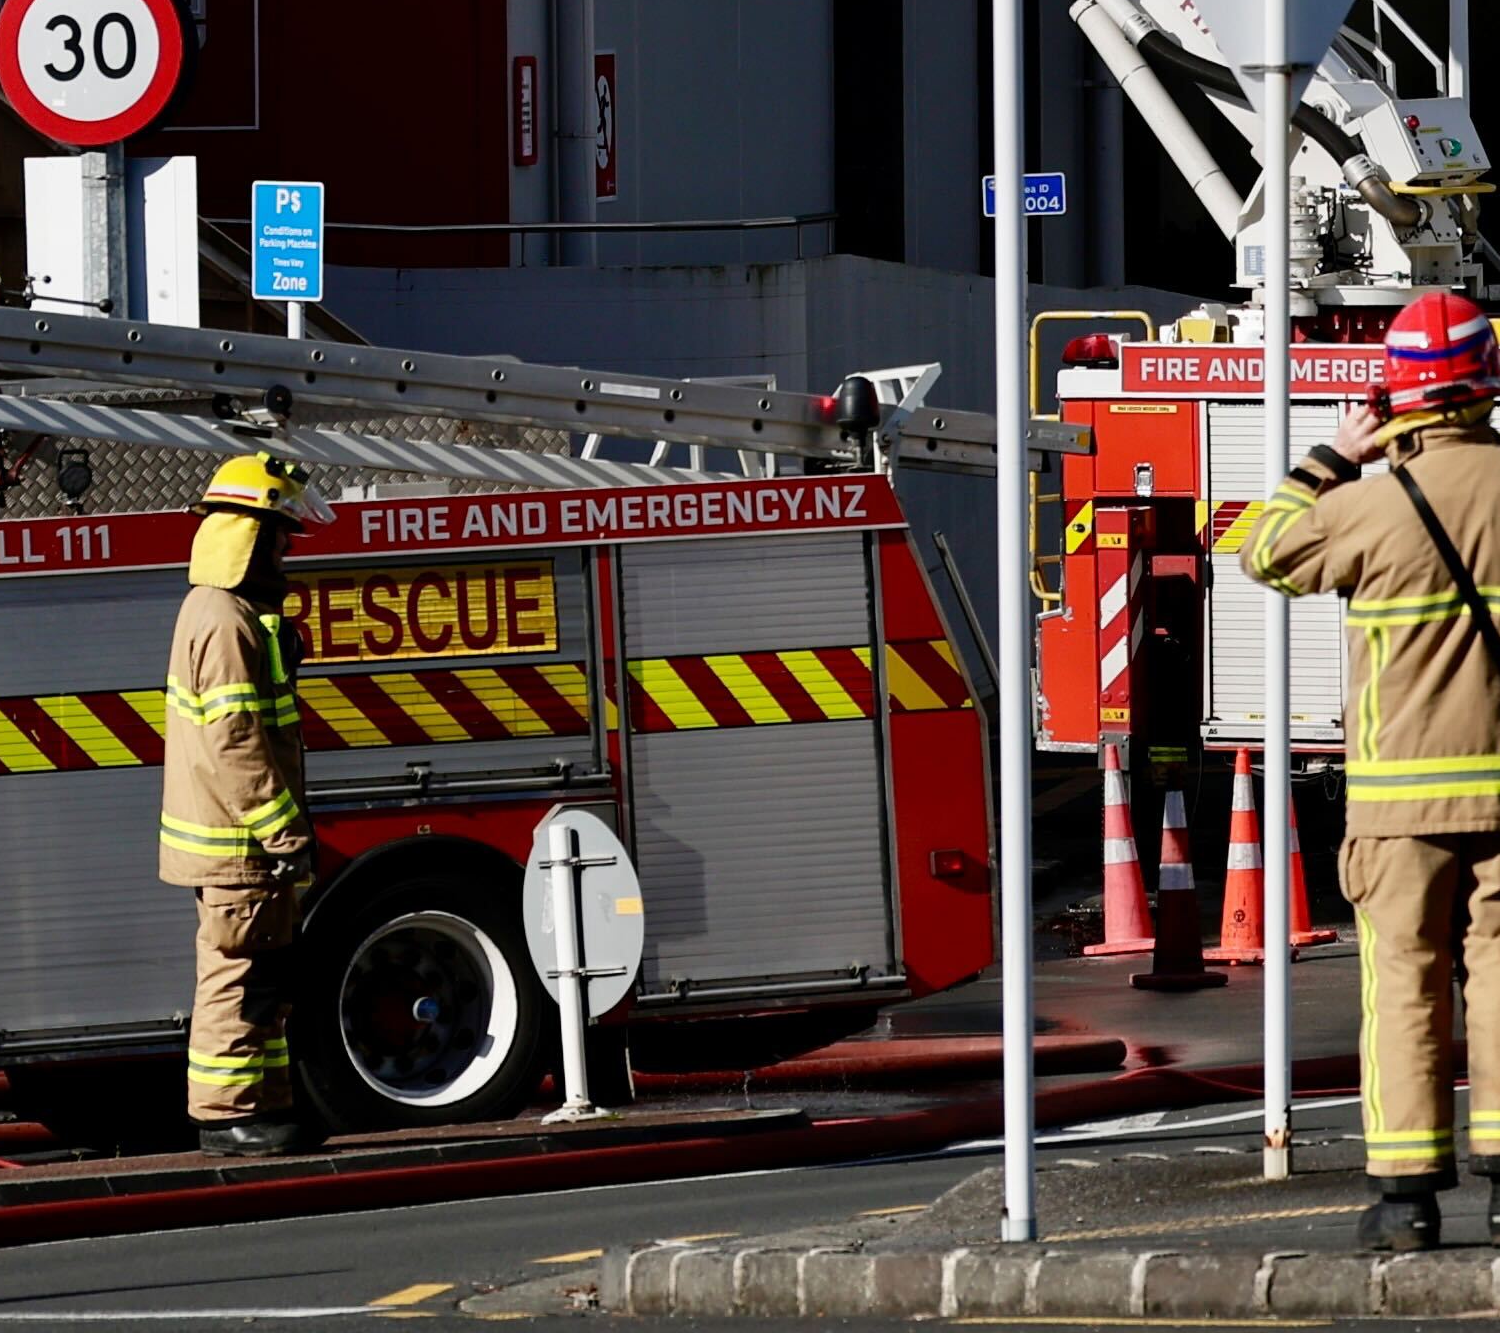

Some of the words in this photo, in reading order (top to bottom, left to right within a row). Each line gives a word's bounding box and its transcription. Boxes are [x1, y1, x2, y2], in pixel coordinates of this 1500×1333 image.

[44, 11, 137, 82] 30
[1038, 184, 1050, 193] ID
[260, 238, 287, 250] Parking
[273, 272, 307, 291] Zone
[1140, 358, 1200, 381] FIRE
[1206, 358, 1264, 382] AND
[361, 506, 451, 543] FIRE
[462, 501, 547, 539] AND
[561, 484, 867, 534] EMERGENCY.NZ
[56, 524, 111, 561] 111
[284, 568, 546, 662] RESCUE
